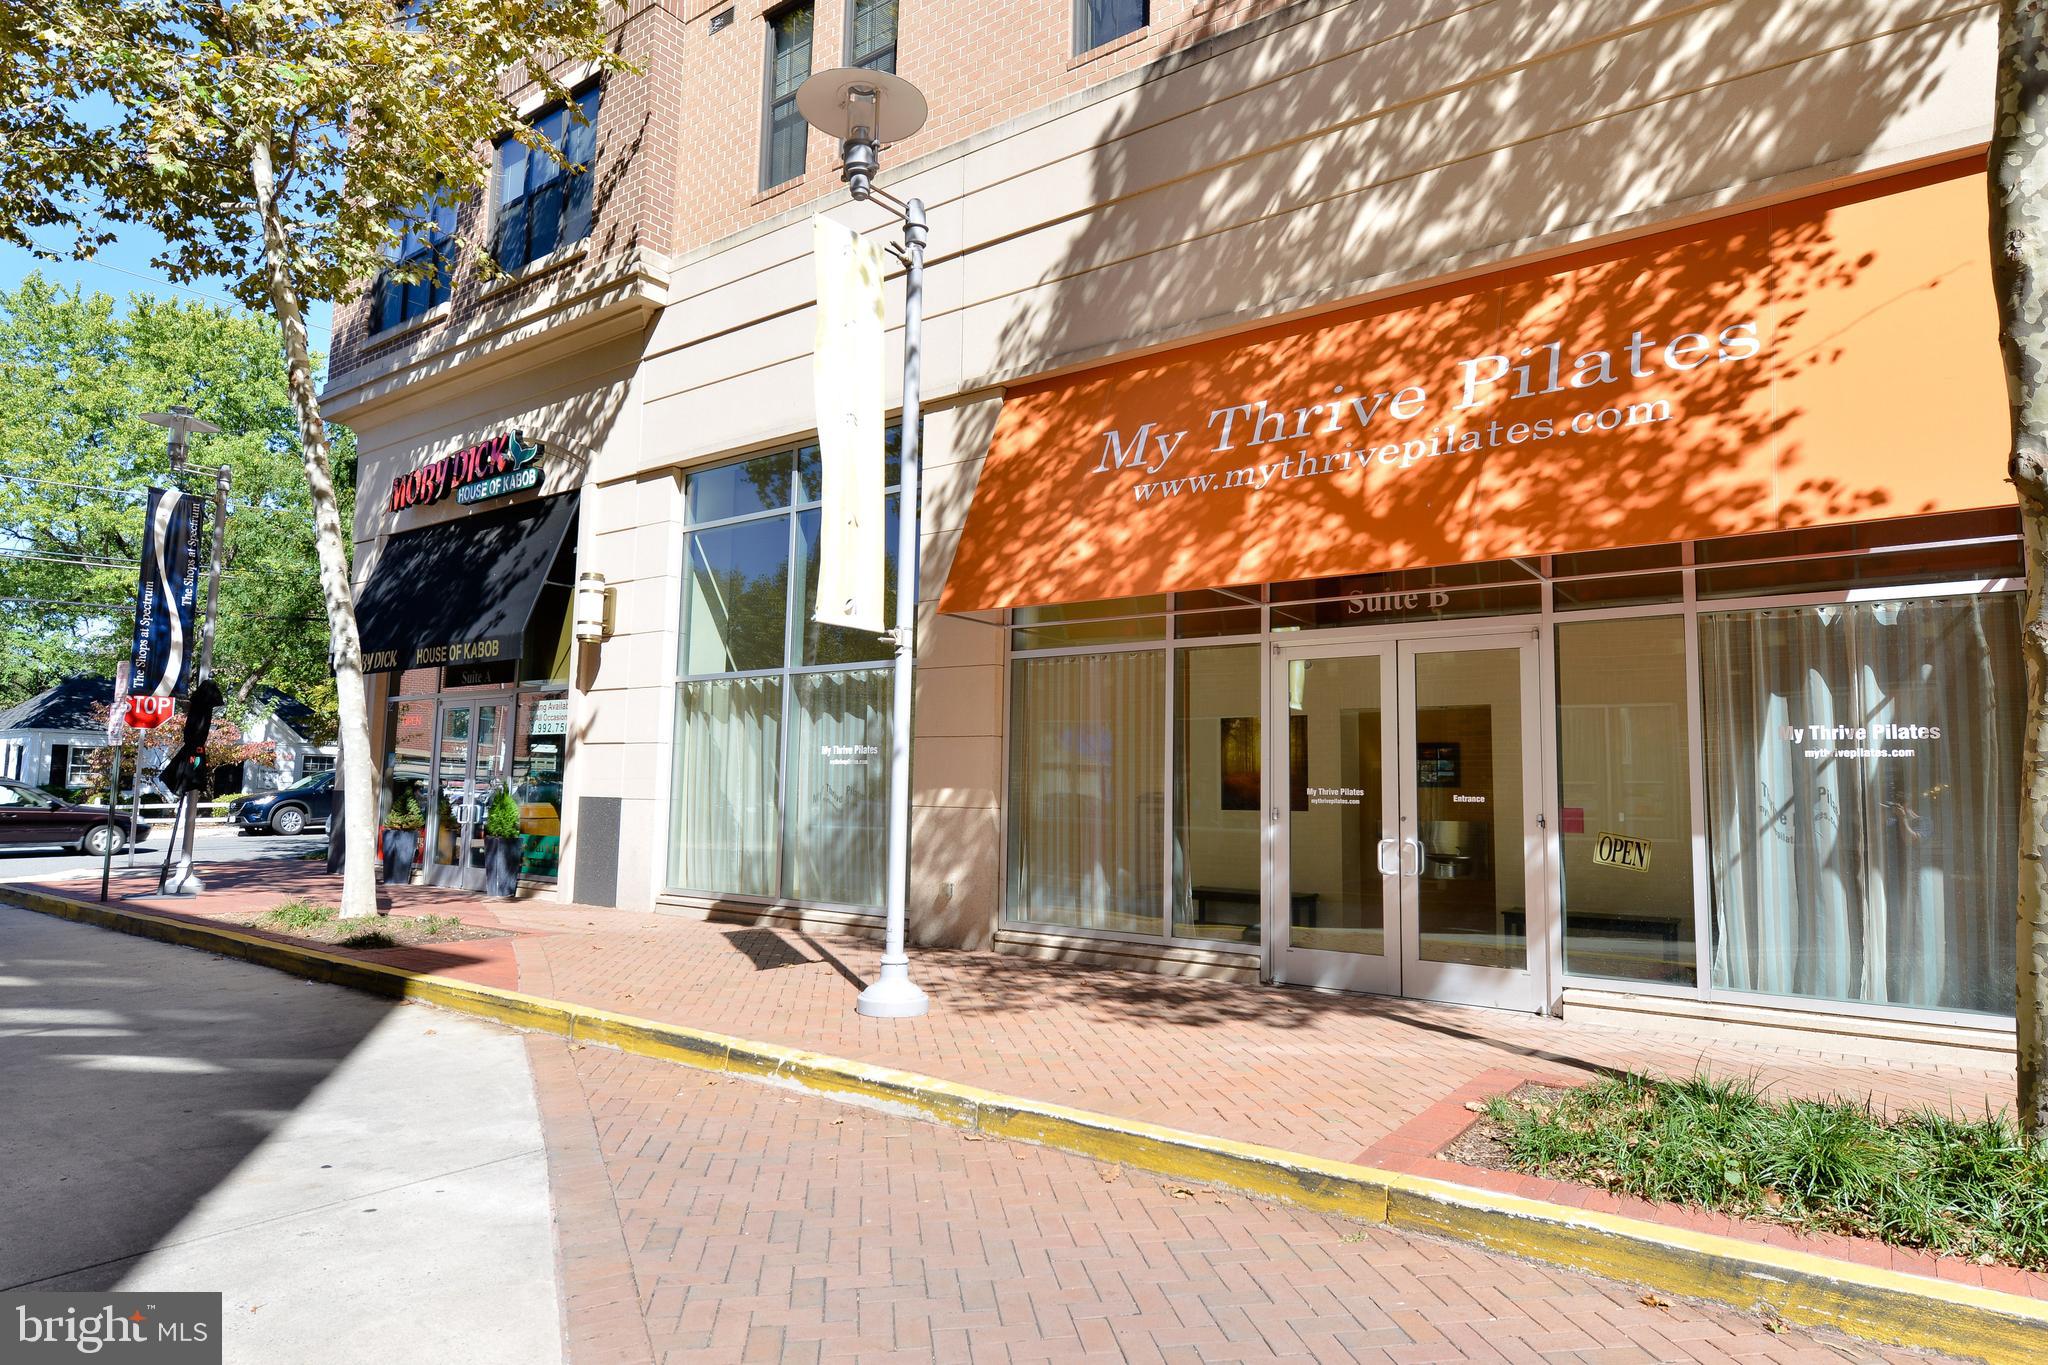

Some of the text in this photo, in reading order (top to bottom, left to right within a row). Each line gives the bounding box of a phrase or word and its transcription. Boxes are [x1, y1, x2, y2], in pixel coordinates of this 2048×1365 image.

[1092, 321, 1761, 474] My Thrive Pilates
[1132, 398, 1674, 503] www.mythrivepilates.com
[389, 432, 509, 513] MOBY DICK
[457, 469, 536, 502] HOUSE OF KABOB
[182, 503, 200, 606] The Shops at Spectrum
[1348, 587, 1418, 614] Suite
[133, 581, 154, 688] The Shops at Spectrum
[362, 649, 398, 672] BY DICK
[416, 640, 499, 664] HOUSE OF KABOB
[125, 695, 170, 715] STOP
[1779, 723, 1942, 744] My Thrive Pilates
[821, 744, 878, 757] My Thrive Pilates
[1306, 788, 1365, 796] My Thrive Pilates
[1453, 794, 1486, 803] Entrance
[1599, 836, 1647, 867] OPEN
